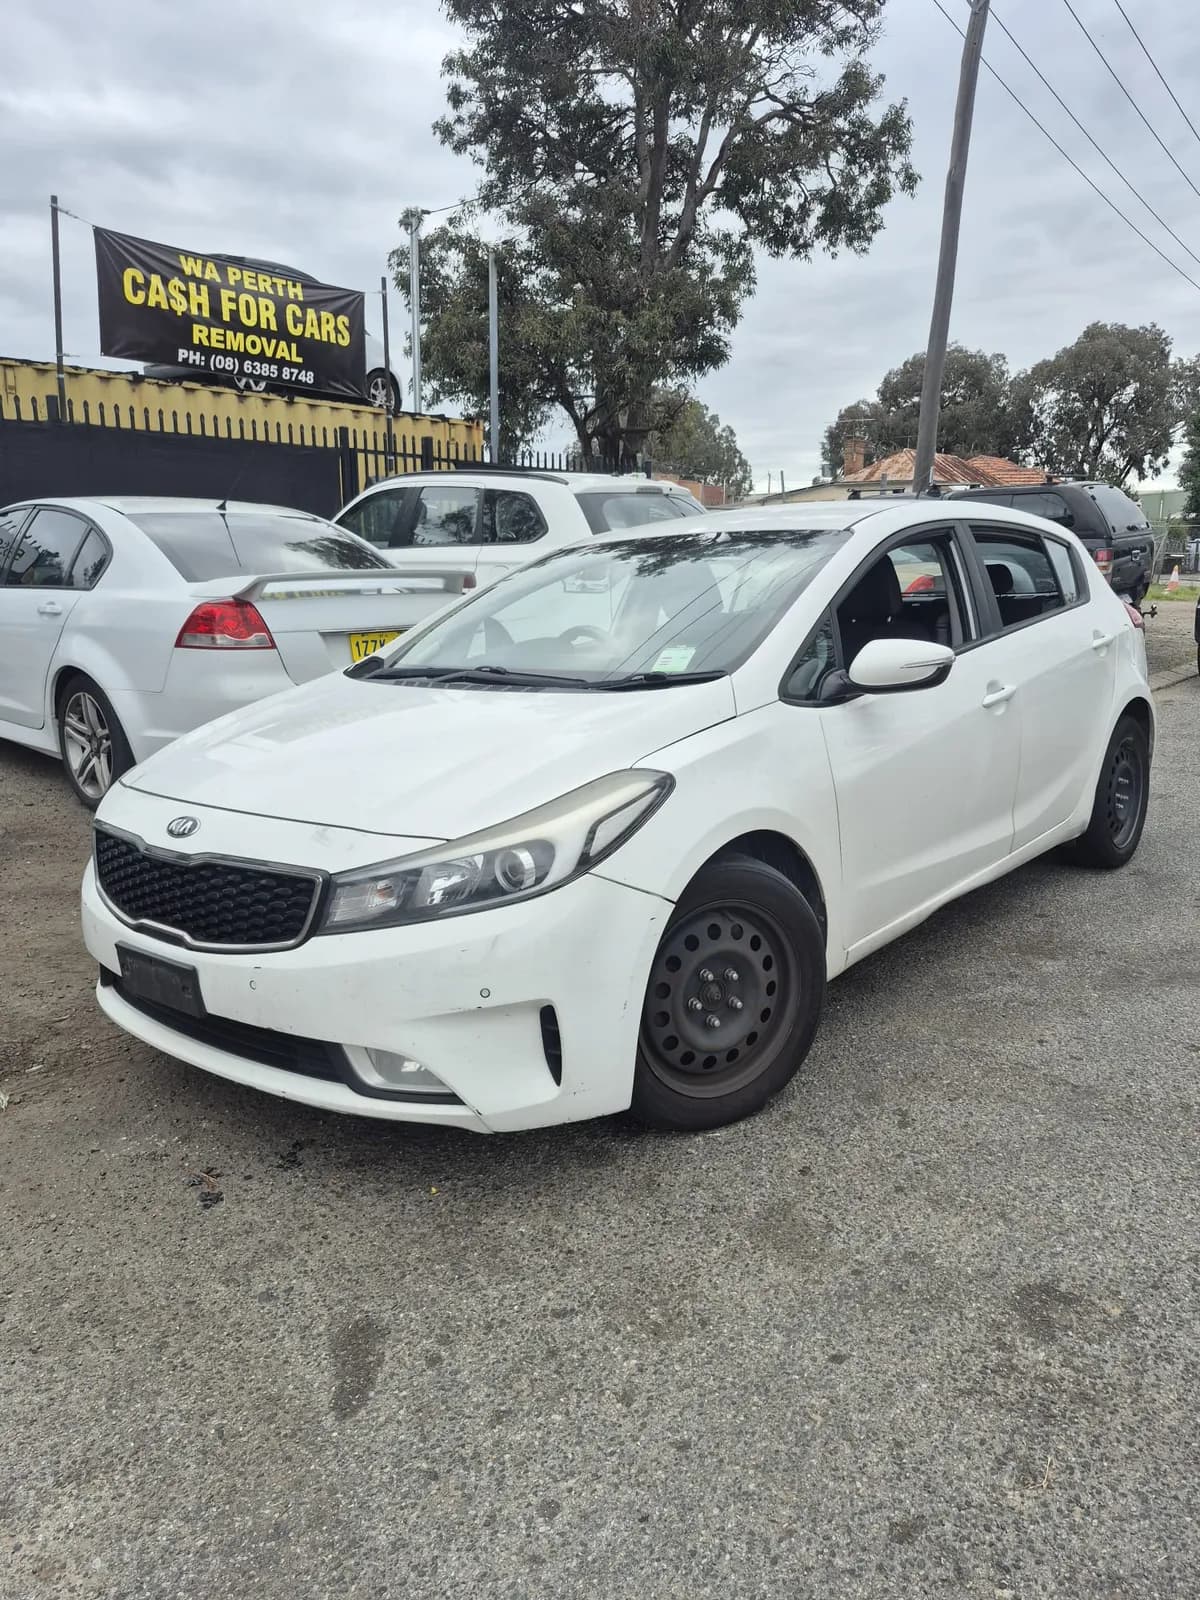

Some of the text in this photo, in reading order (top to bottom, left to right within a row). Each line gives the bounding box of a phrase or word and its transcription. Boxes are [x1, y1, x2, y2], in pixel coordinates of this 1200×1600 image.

[179, 255, 304, 301] WA PERTH
[123, 268, 350, 347] CA$H FOR CARS
[192, 324, 303, 363] REMOVAL
[178, 348, 314, 384] PH: (08) 6385 8748
